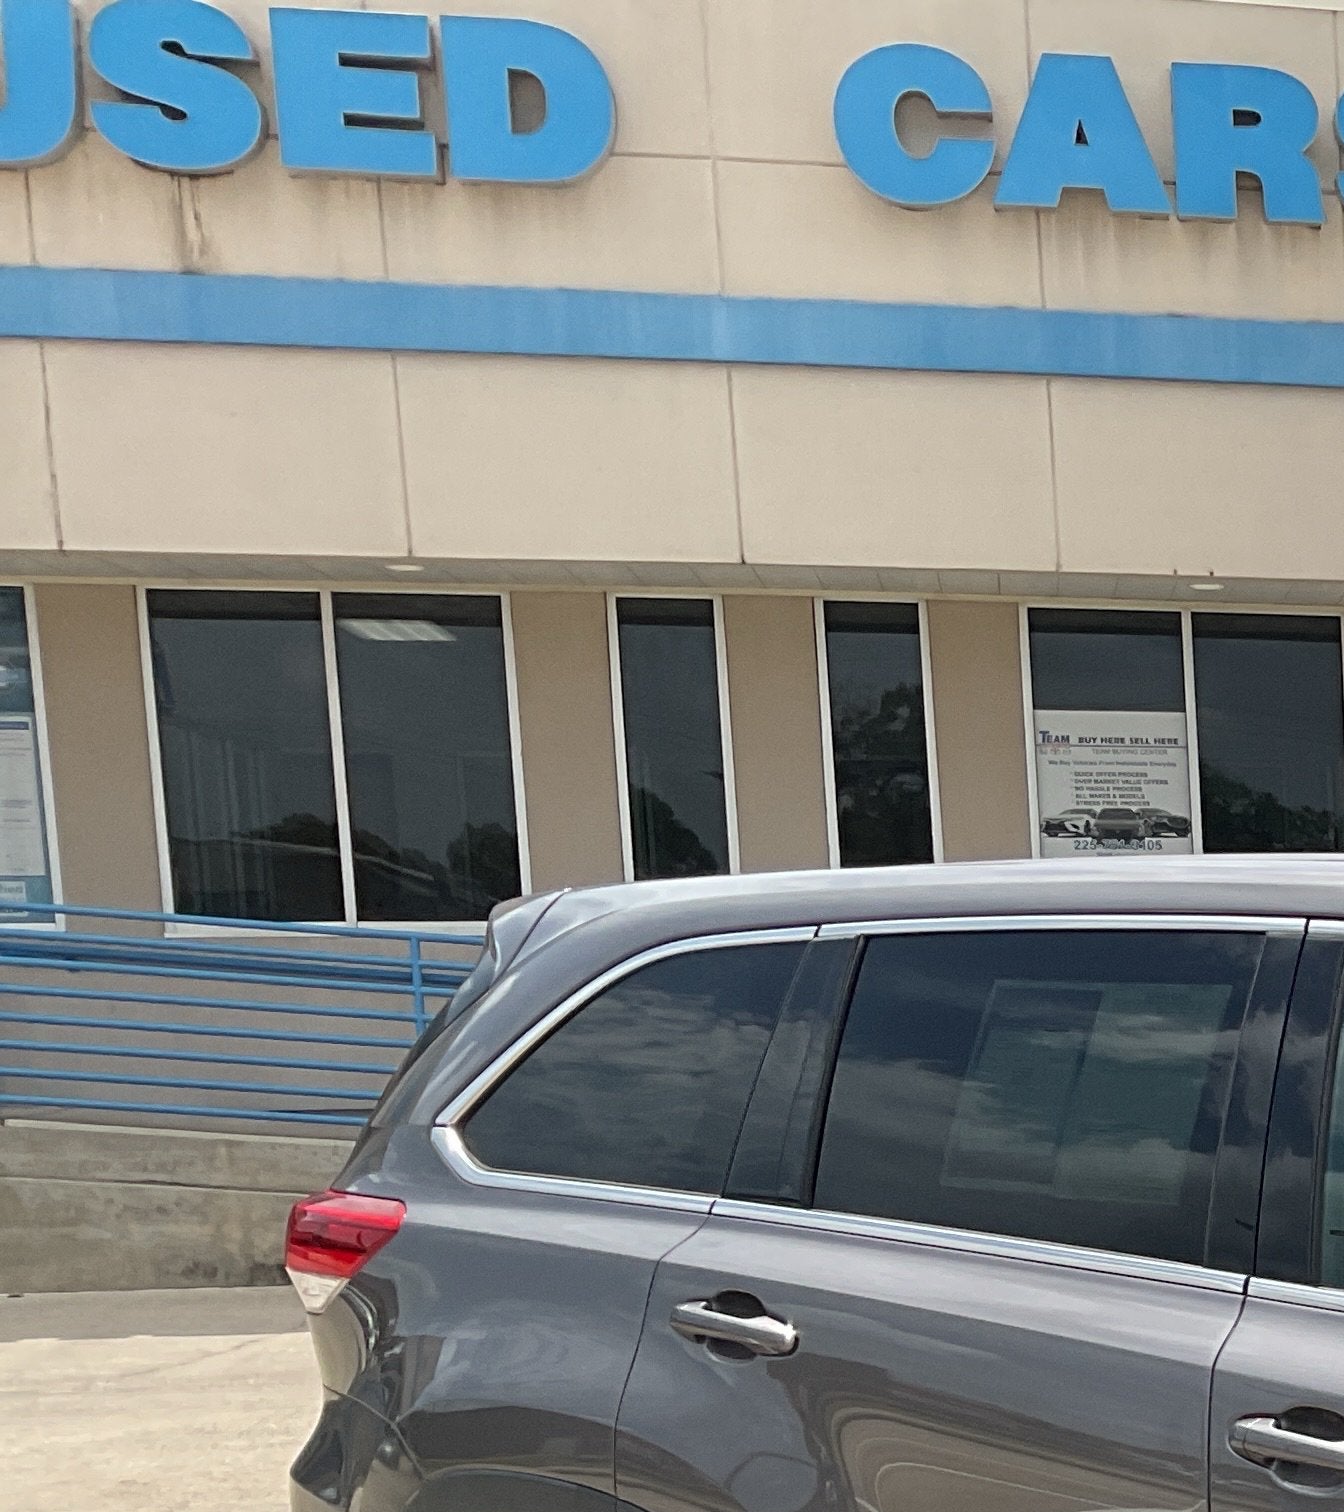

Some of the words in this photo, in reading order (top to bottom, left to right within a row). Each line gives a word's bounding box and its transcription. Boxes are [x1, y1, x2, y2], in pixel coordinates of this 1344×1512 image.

[1039, 730, 1071, 744] TEAM
[1078, 736, 1098, 744] BUY
[1100, 737, 1126, 745] HERE
[1129, 737, 1151, 745] SELL
[1153, 737, 1179, 745] HERE
